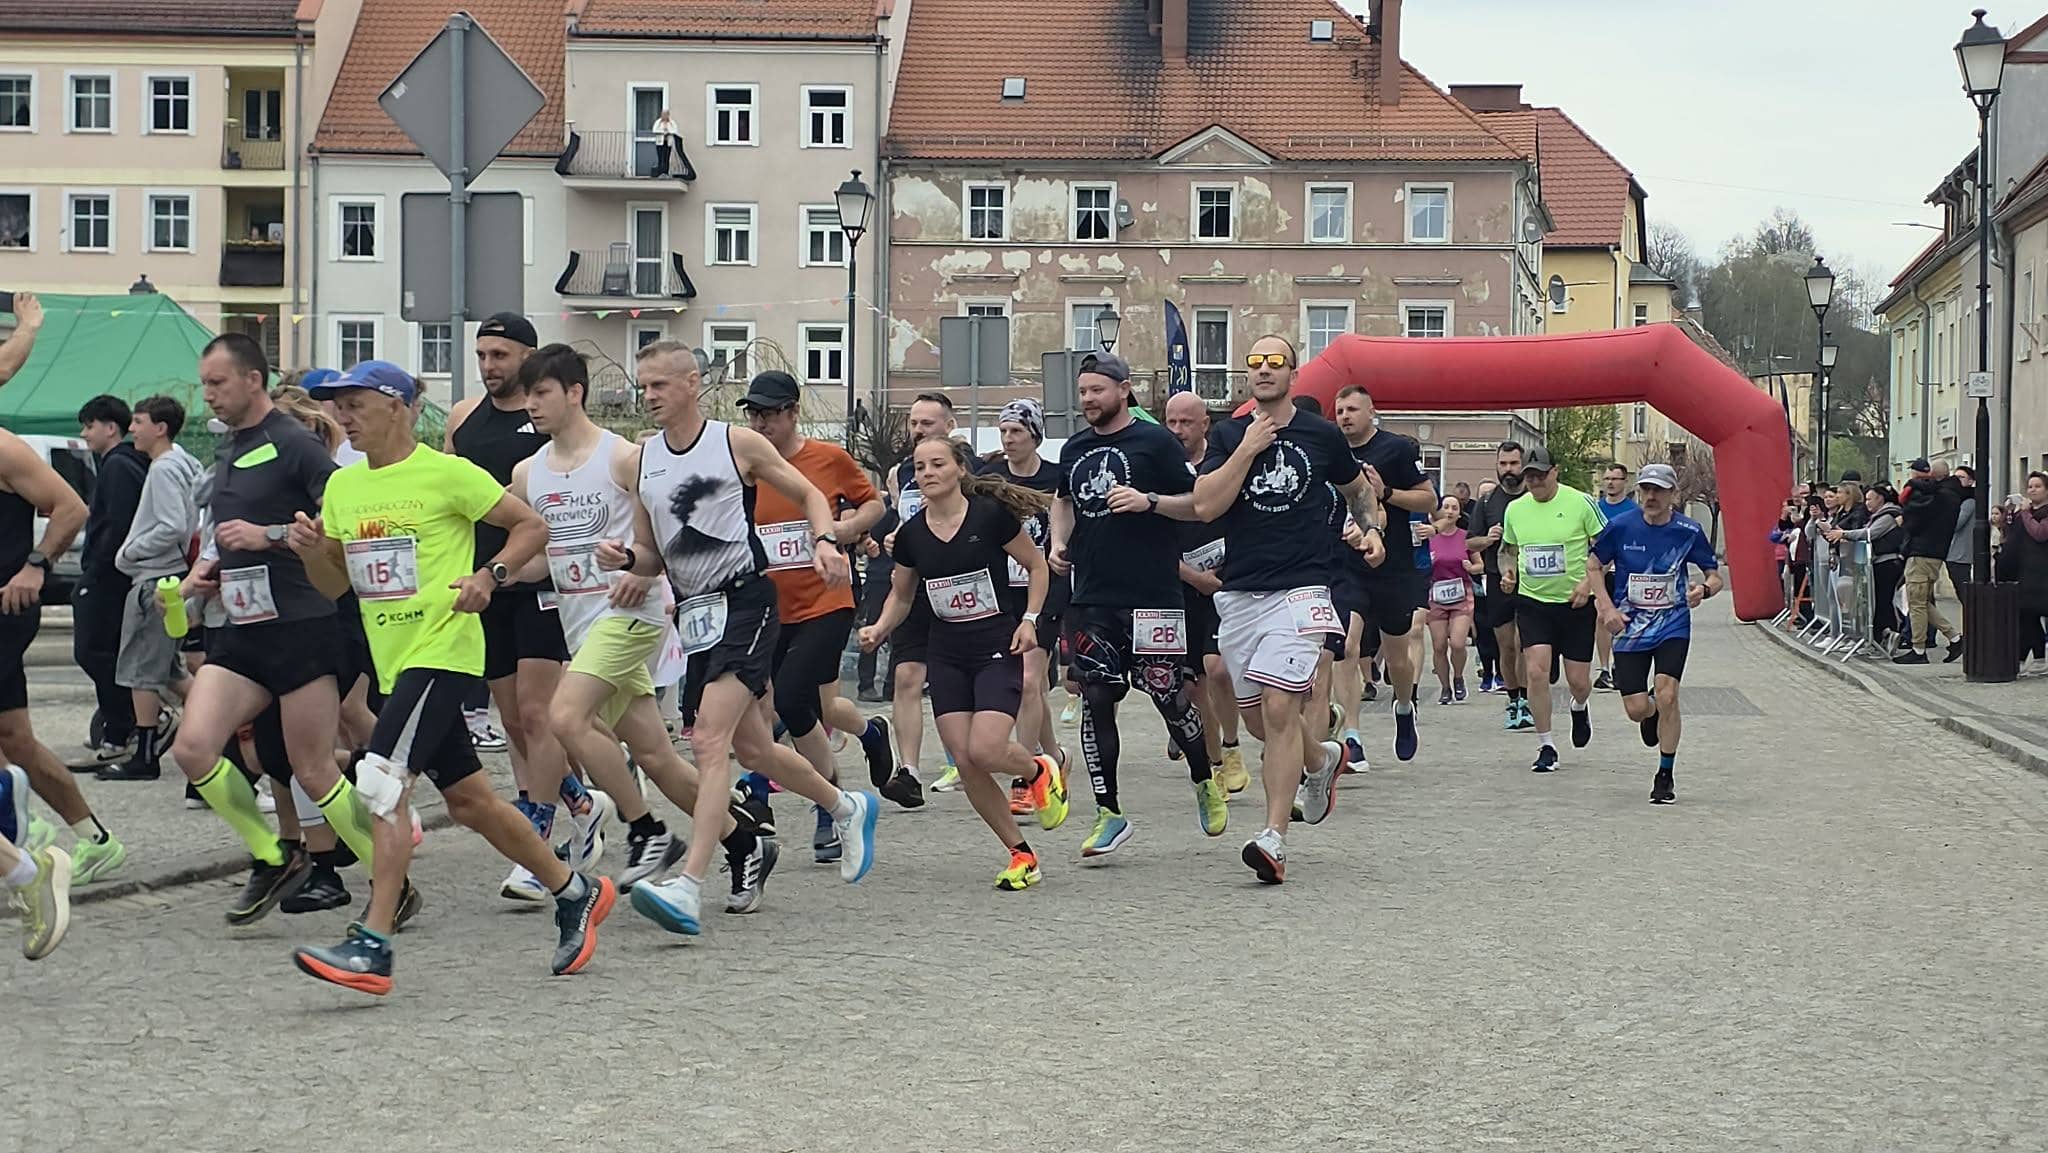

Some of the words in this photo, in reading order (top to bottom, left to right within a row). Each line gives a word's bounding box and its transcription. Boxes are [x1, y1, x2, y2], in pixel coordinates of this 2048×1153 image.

[1529, 450, 1538, 462] A
[570, 492, 601, 507] MLKS
[779, 540, 799, 557] 61
[1533, 556, 1556, 569] 108
[366, 562, 391, 585] 15
[569, 564, 581, 582] 3
[233, 591, 246, 609] 4
[950, 591, 977, 610] 49
[1644, 588, 1664, 600] 57
[1310, 606, 1333, 621] 25
[1152, 627, 1175, 643] 26
